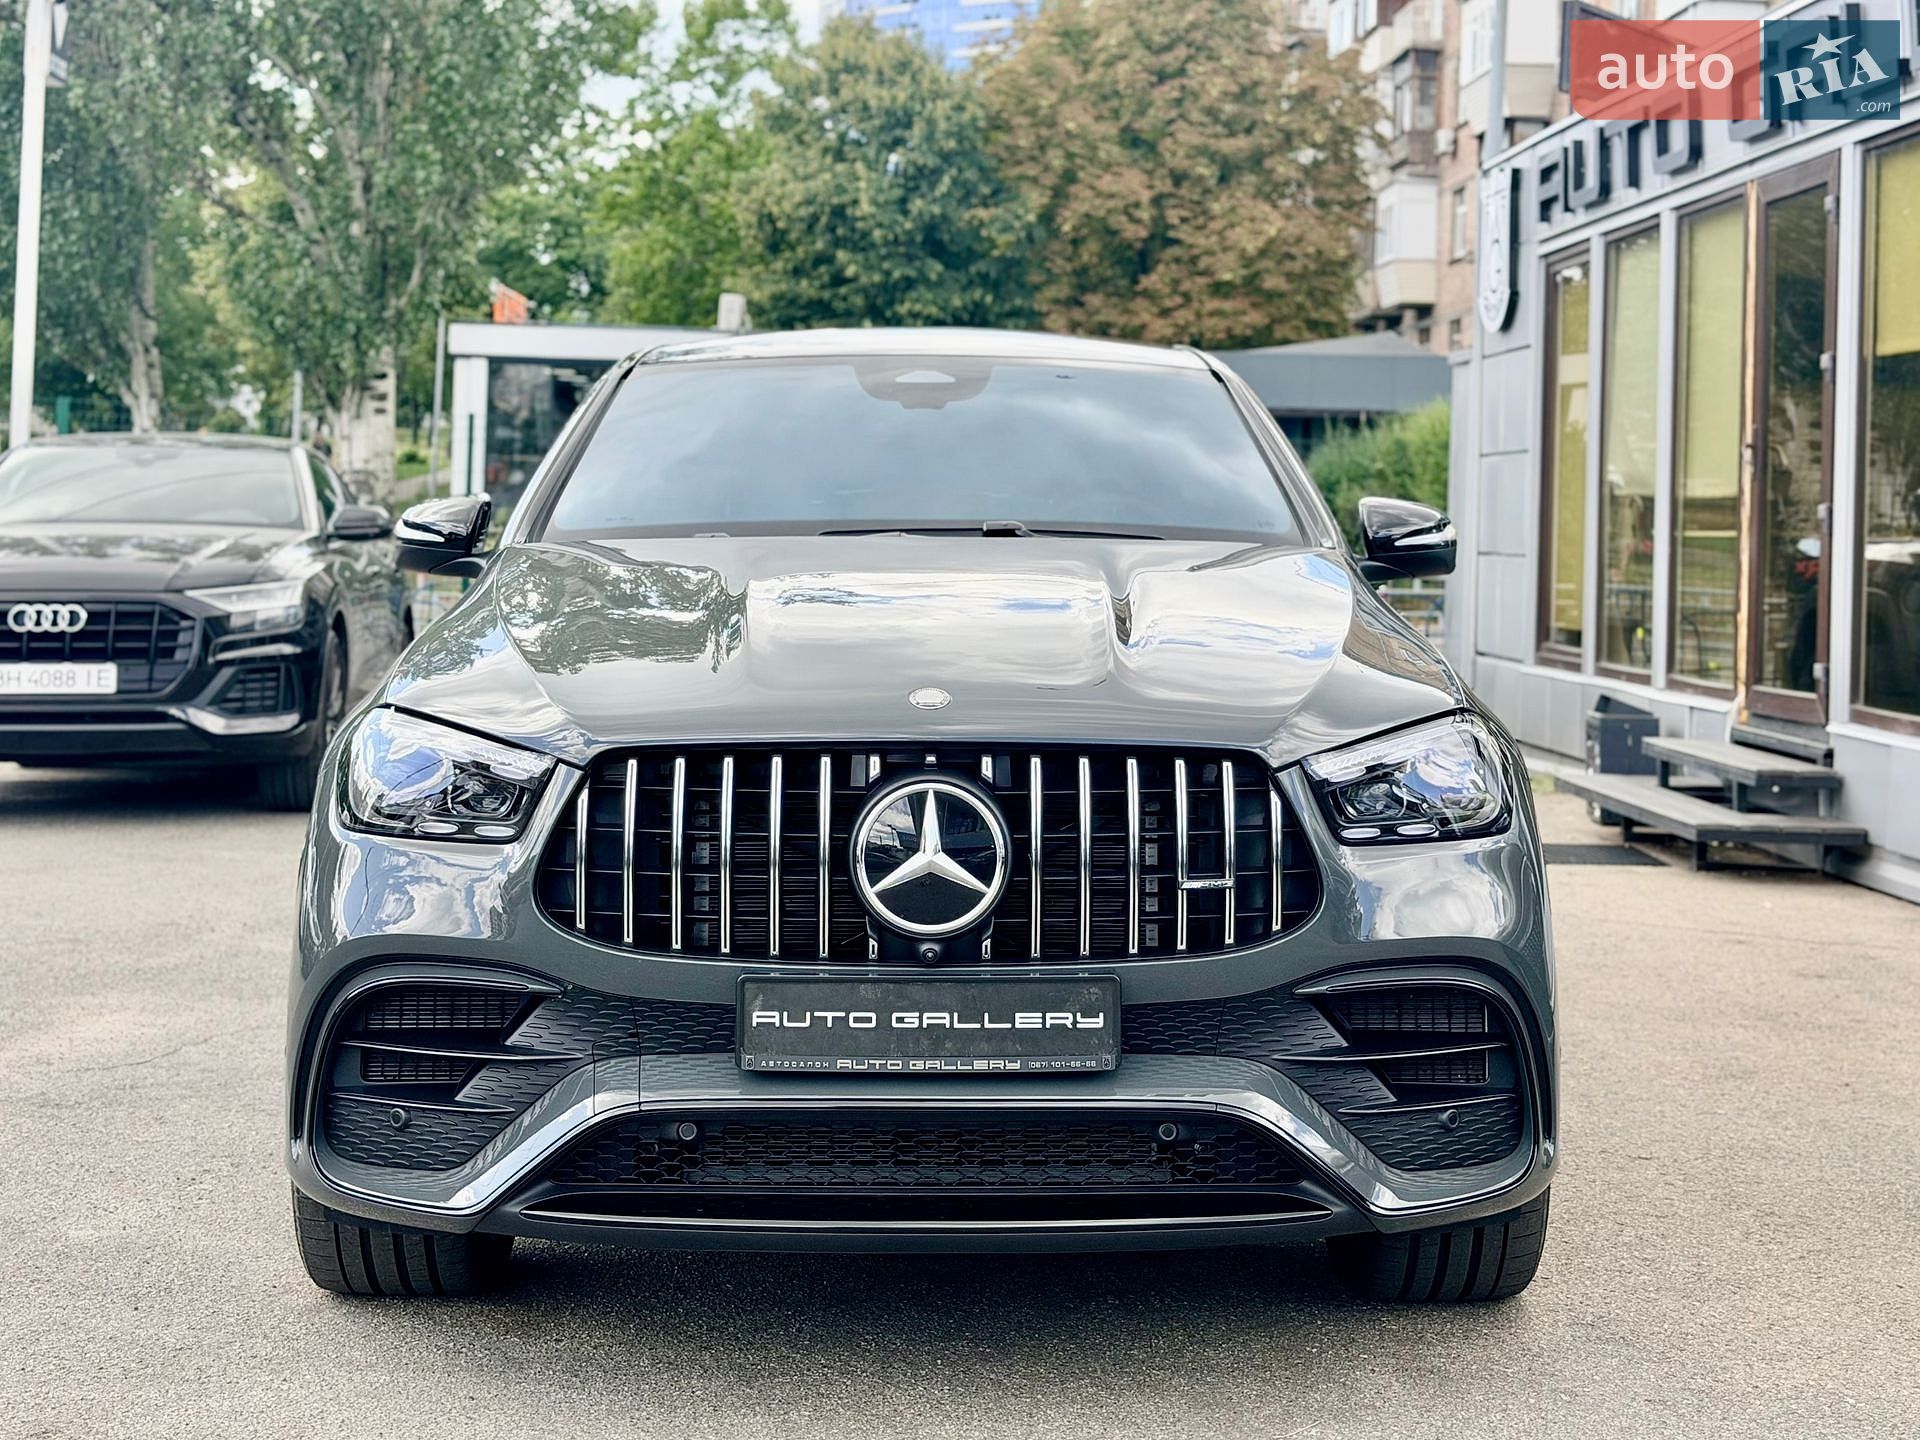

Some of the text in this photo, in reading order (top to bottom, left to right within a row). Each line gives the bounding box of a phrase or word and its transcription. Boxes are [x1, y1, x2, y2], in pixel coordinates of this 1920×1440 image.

[27, 669, 77, 689] 4088
[751, 1011, 1104, 1029] AUTO GALLERY
[836, 1060, 902, 1070] AUTO
[909, 1060, 1021, 1070] GALLERY
